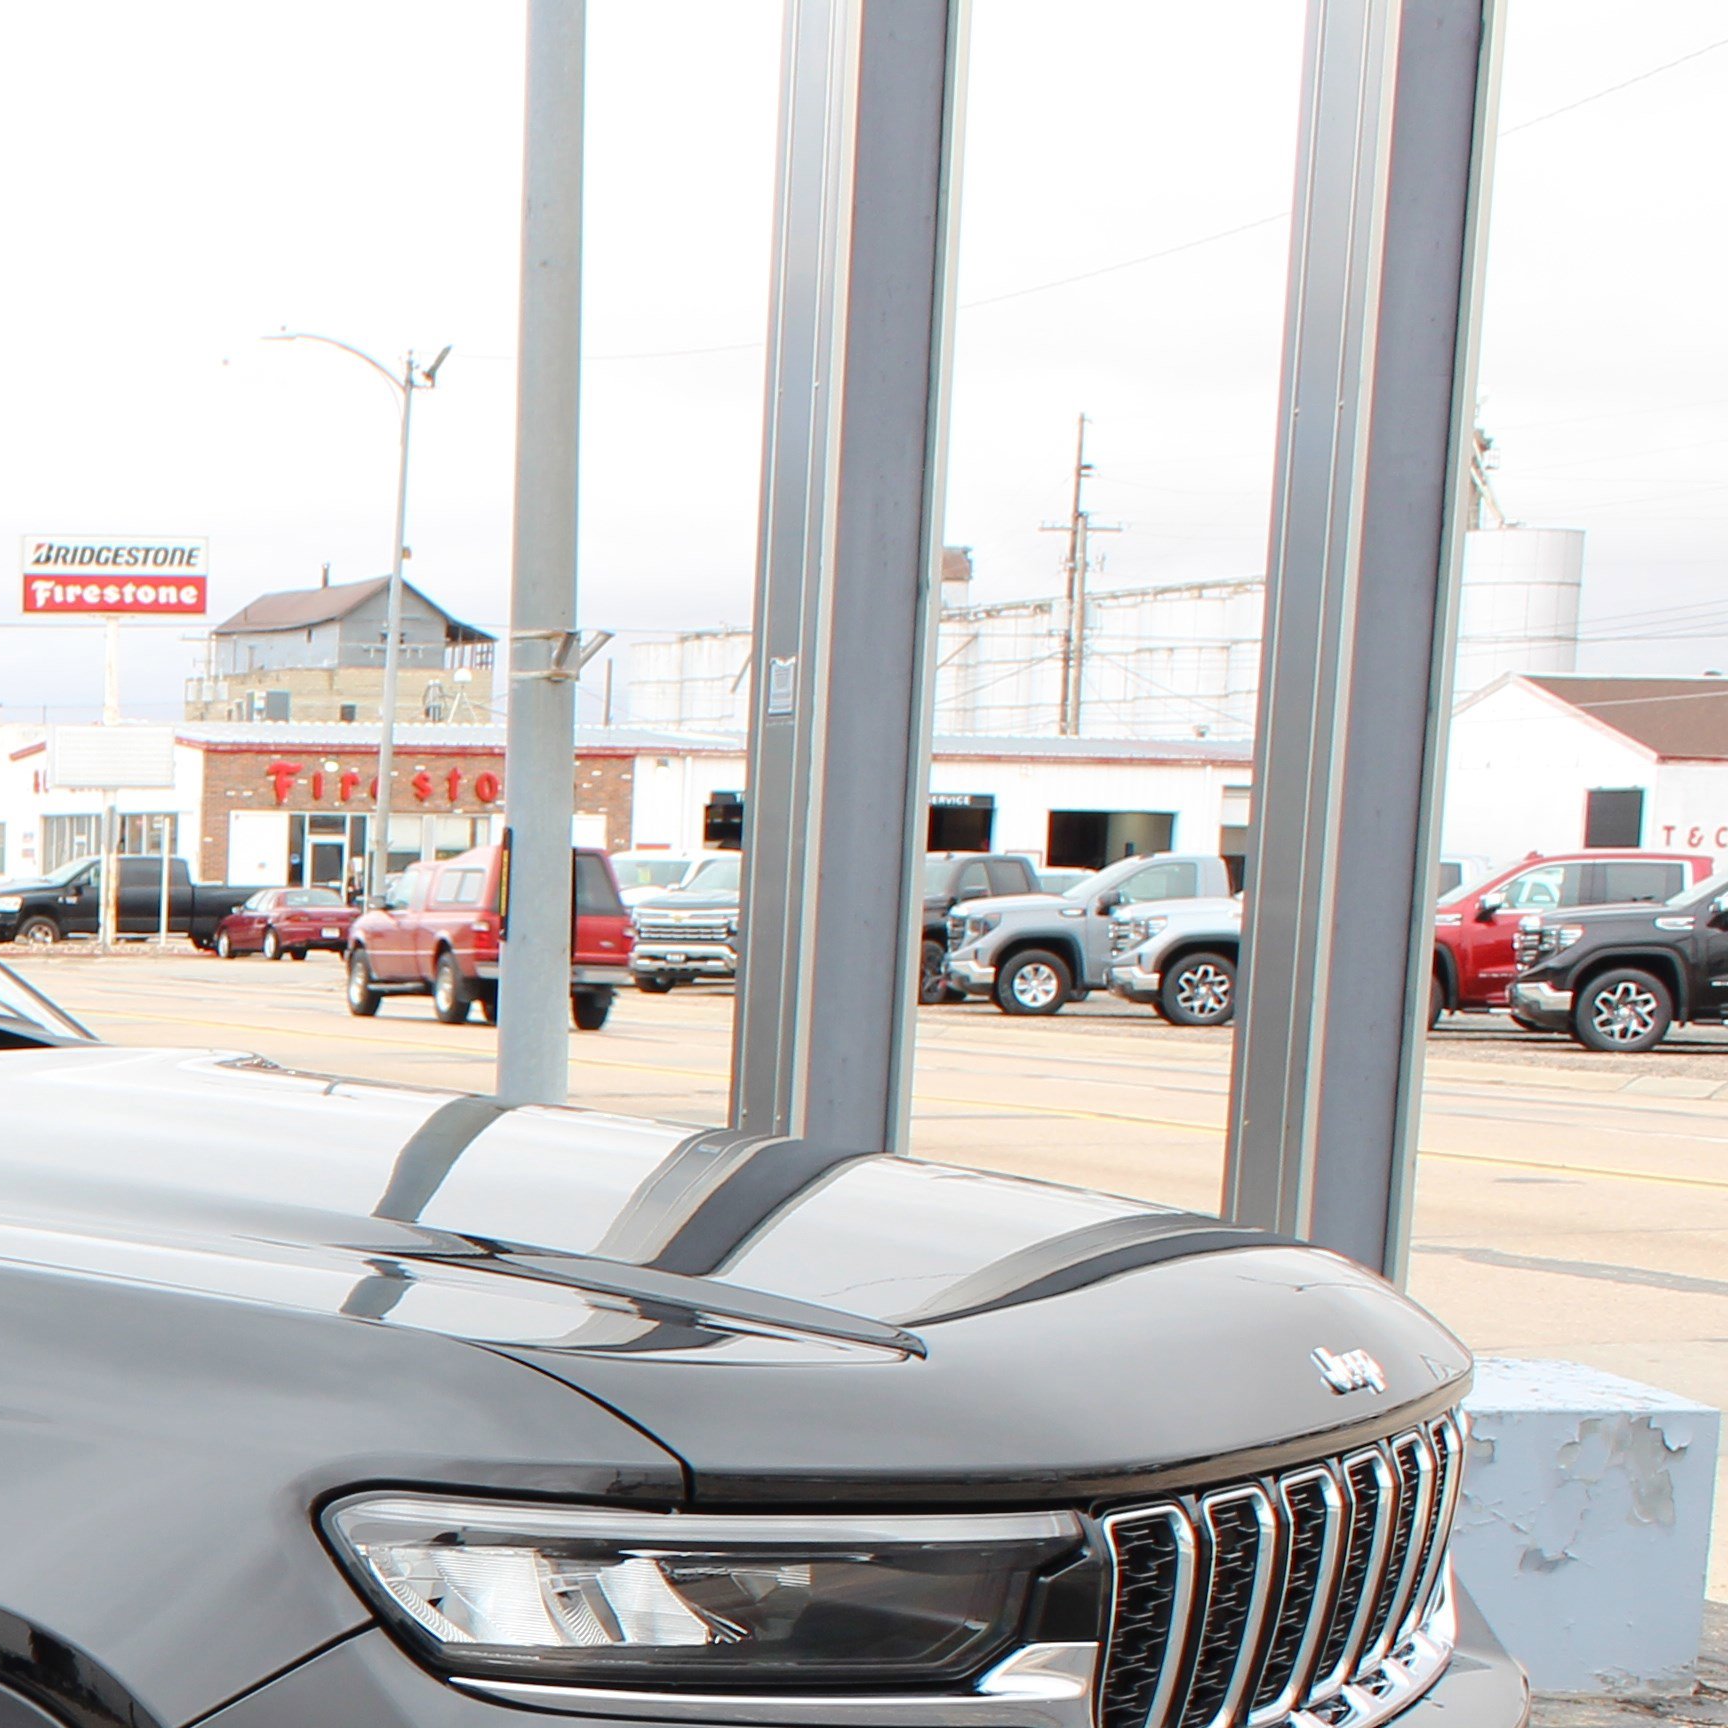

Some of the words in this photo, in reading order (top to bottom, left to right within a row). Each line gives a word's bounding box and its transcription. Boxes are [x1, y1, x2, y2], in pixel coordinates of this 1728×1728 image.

[31, 542, 202, 568] BRIDGESTONE
[30, 579, 199, 608] Firestone
[928, 796, 971, 807] ERVICE
